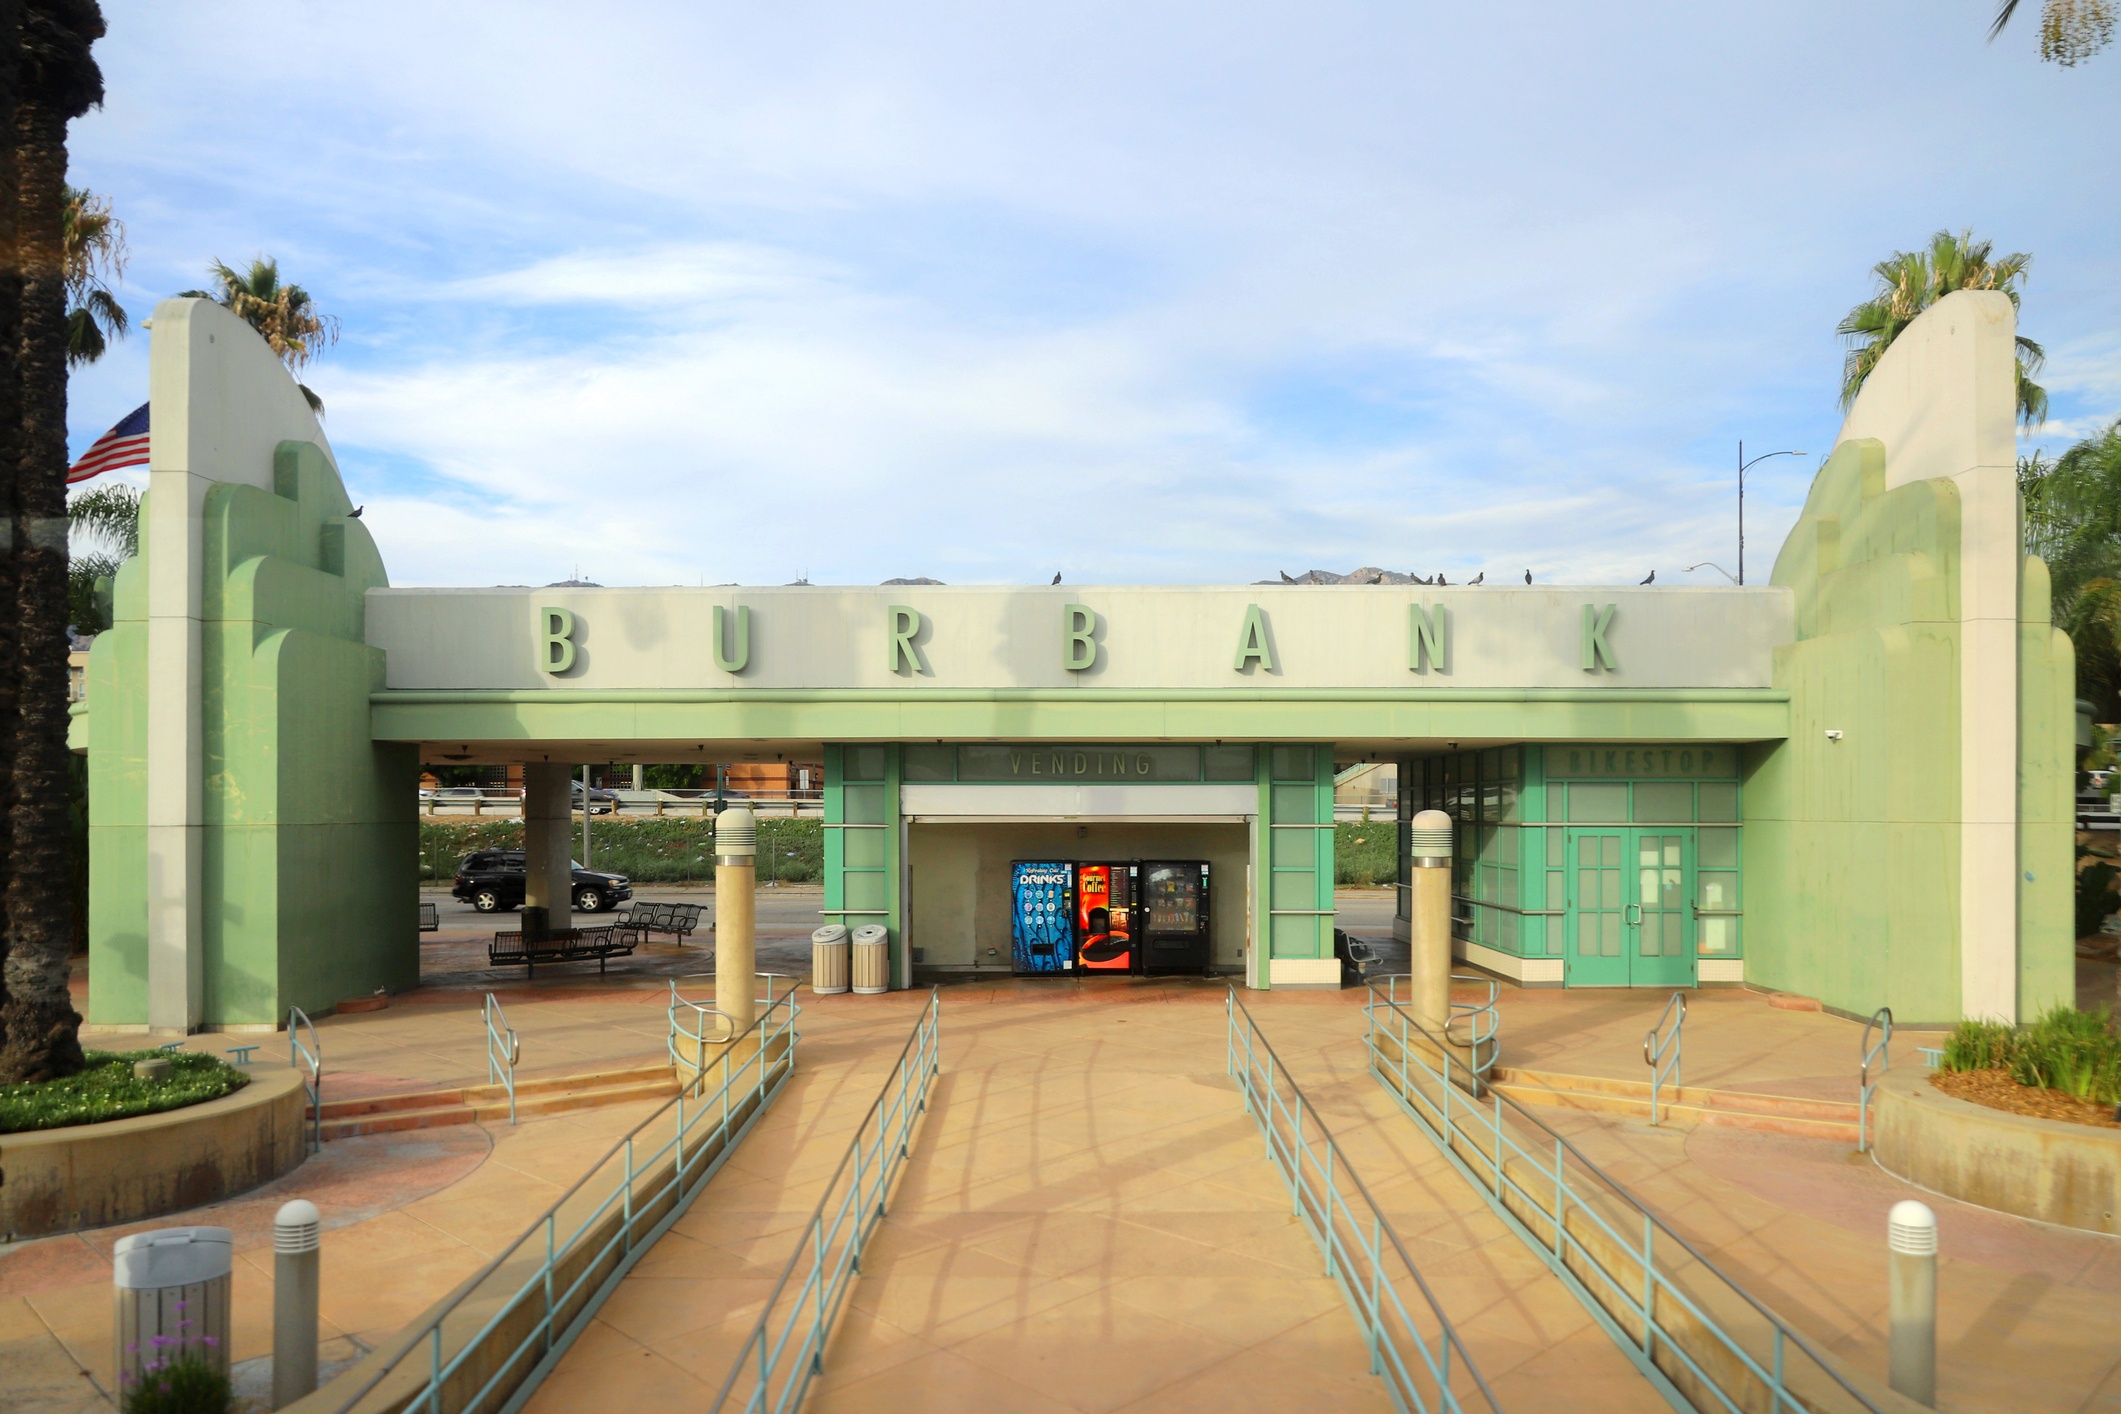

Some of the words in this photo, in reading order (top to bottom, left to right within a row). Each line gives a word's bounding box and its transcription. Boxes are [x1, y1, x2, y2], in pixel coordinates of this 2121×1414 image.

[541, 602, 1618, 673] BURBANK
[1010, 752, 1151, 775] VENDING
[1569, 750, 1714, 773] BIKESTOP
[1020, 874, 1065, 885] DRINKS
[1082, 873, 1106, 882] Gourmet
[1082, 881, 1106, 893] Coffee
